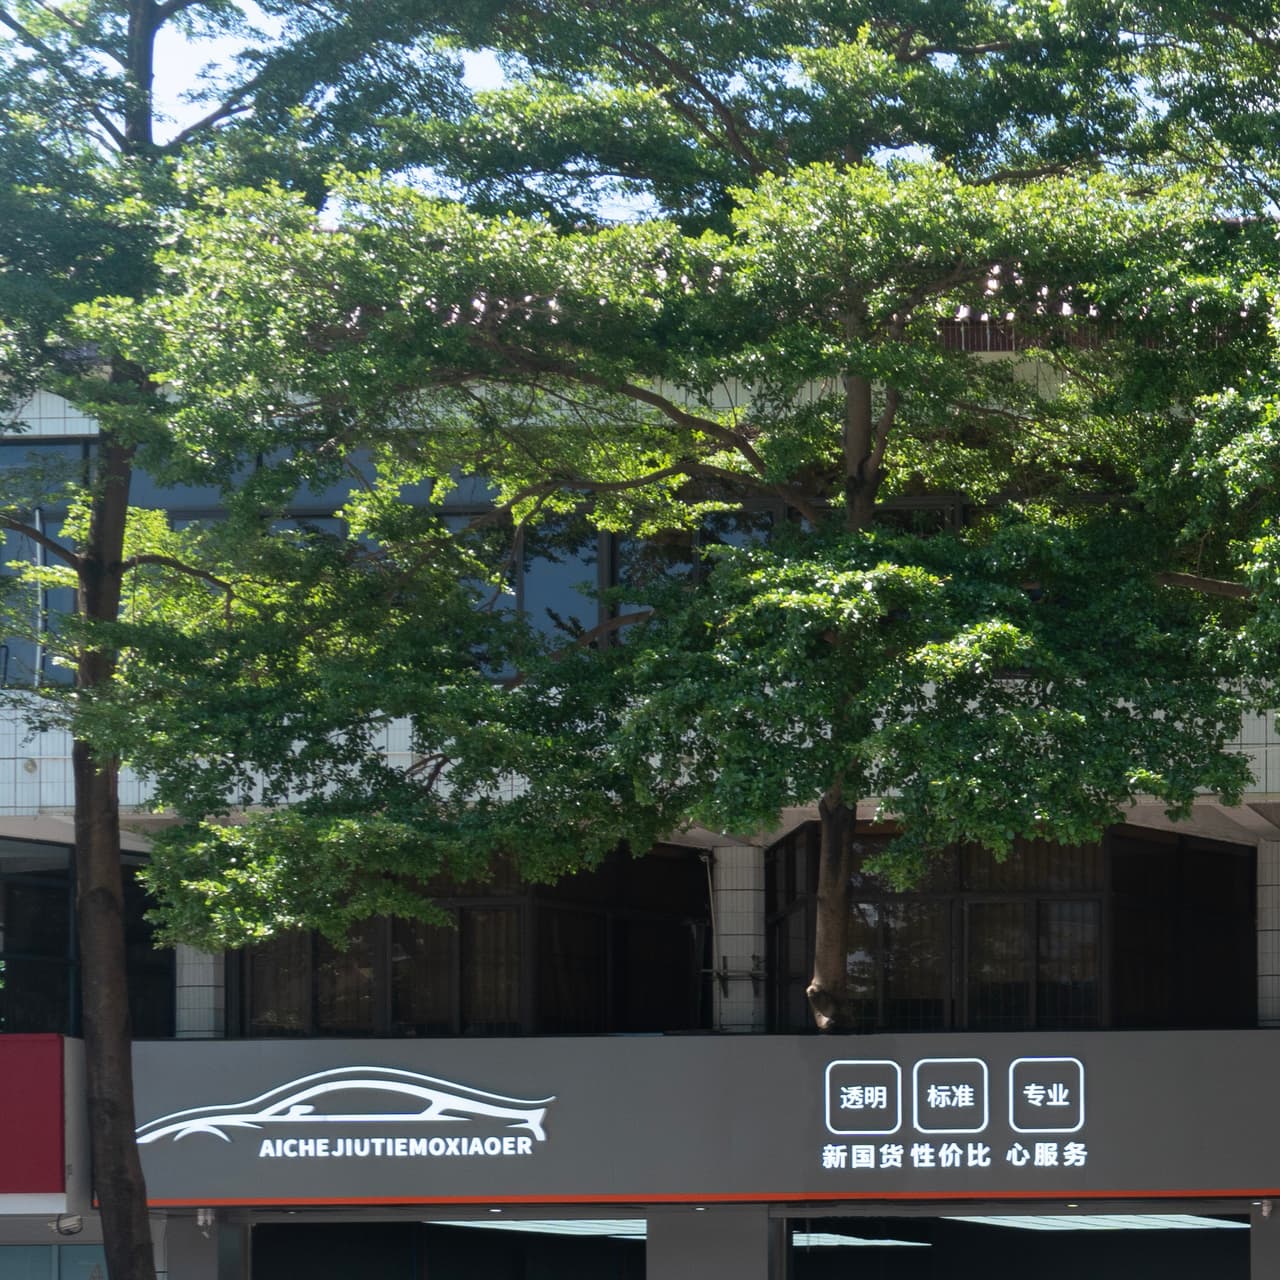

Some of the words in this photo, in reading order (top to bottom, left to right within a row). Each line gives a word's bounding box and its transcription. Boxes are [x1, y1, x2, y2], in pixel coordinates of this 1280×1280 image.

[839, 1085, 887, 1110] 透明
[927, 1084, 975, 1109] 标准
[1022, 1083, 1070, 1107] 专业
[259, 1136, 533, 1158] AICHEJIUTIEMOXIAOER
[822, 1143, 905, 1169] 新国货
[909, 1142, 992, 1168] 性价比
[1005, 1141, 1088, 1167] 心服务
